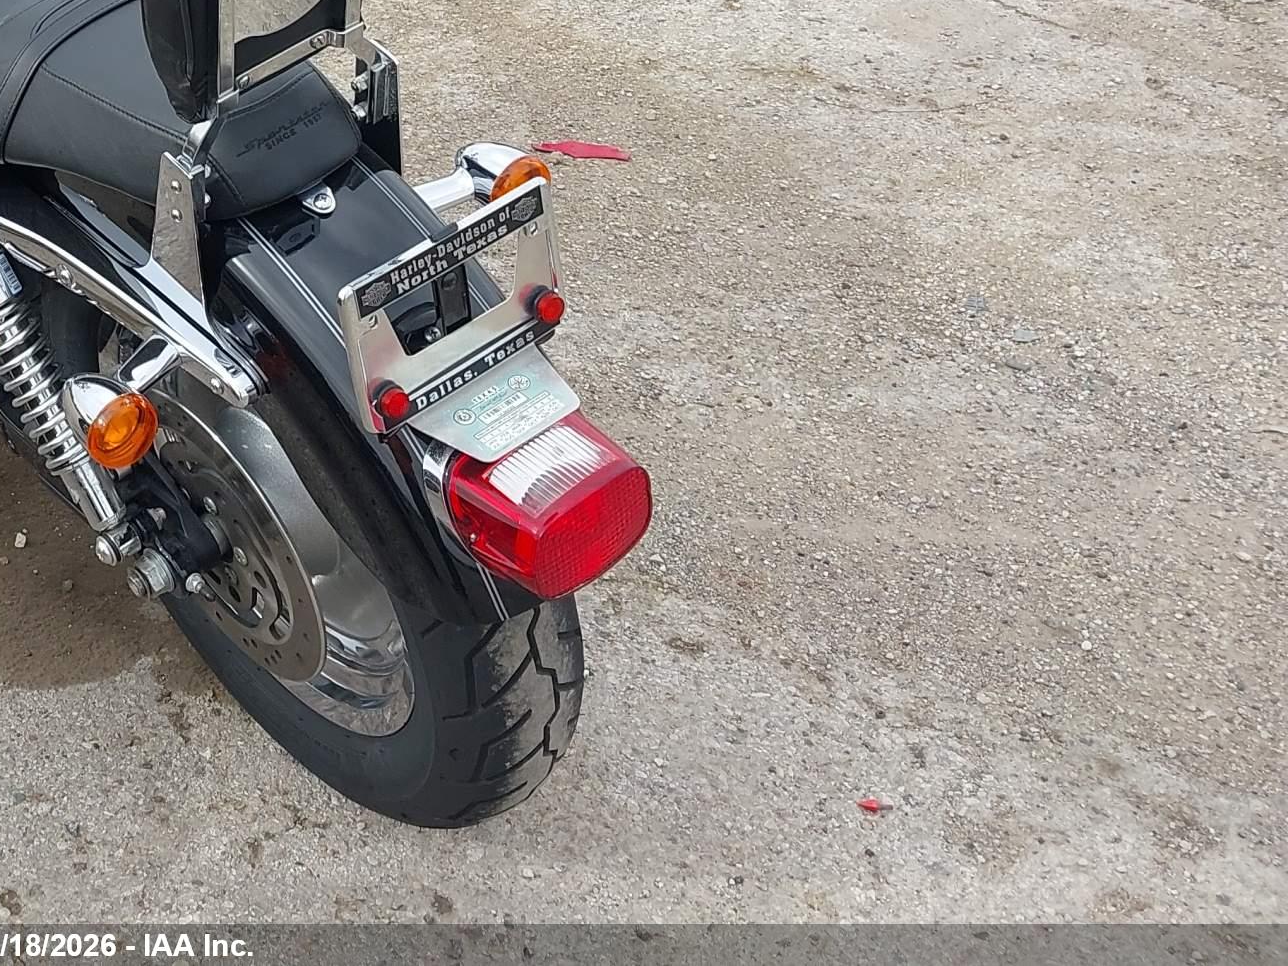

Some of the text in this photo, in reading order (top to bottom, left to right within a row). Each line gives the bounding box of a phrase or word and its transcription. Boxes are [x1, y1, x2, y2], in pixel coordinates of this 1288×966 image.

[265, 128, 297, 150] SINCE
[390, 218, 496, 285] Harley-Davidson
[499, 206, 511, 223] of
[396, 259, 448, 295] North
[453, 225, 508, 261] Texas
[415, 330, 535, 411] Dallas, Texas
